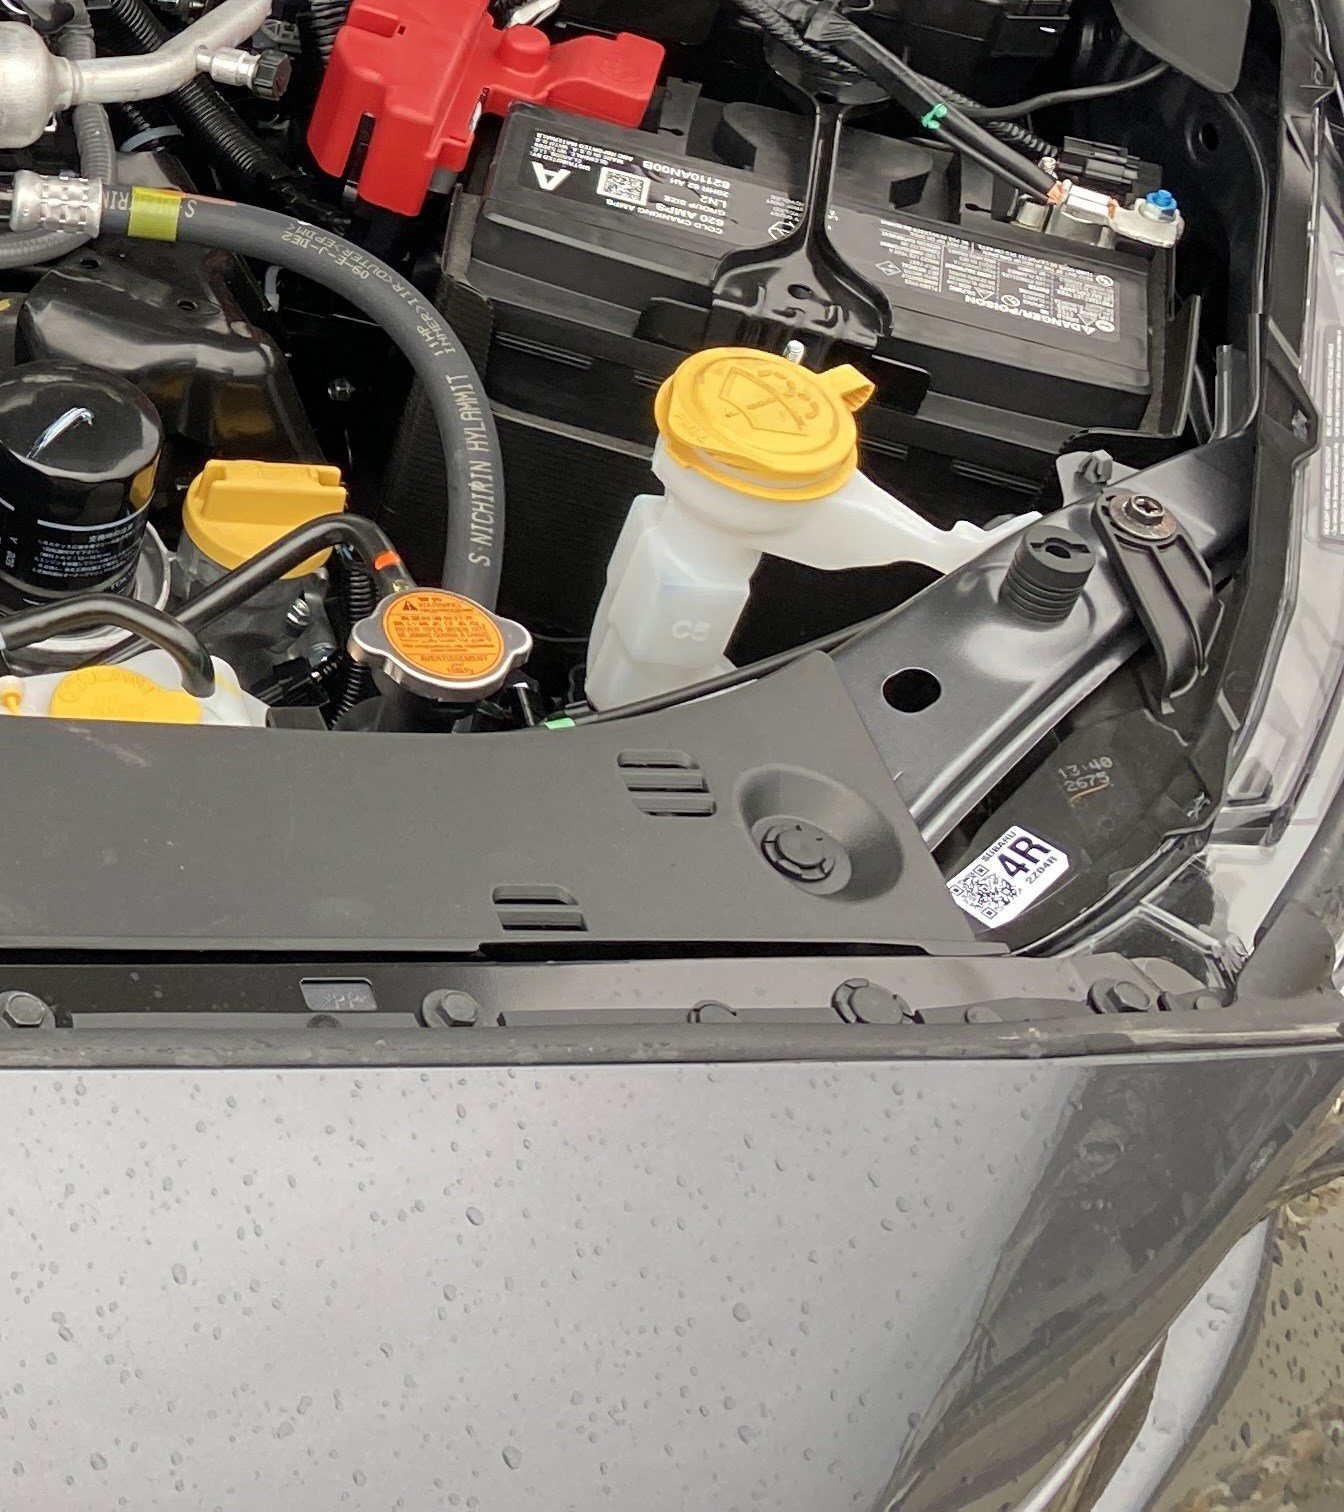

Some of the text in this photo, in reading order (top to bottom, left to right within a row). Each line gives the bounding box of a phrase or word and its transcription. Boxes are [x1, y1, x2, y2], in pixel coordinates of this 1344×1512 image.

[532, 161, 571, 191] A
[605, 198, 724, 235] COLD CRANKING AMPS
[655, 202, 724, 226] 620 AMPS
[663, 195, 726, 217] GROUP SIZE
[699, 196, 727, 208] LN2
[445, 374, 490, 452] HYLAMMIT
[980, 830, 1017, 862] SUBARU
[997, 835, 1052, 878] 4R
